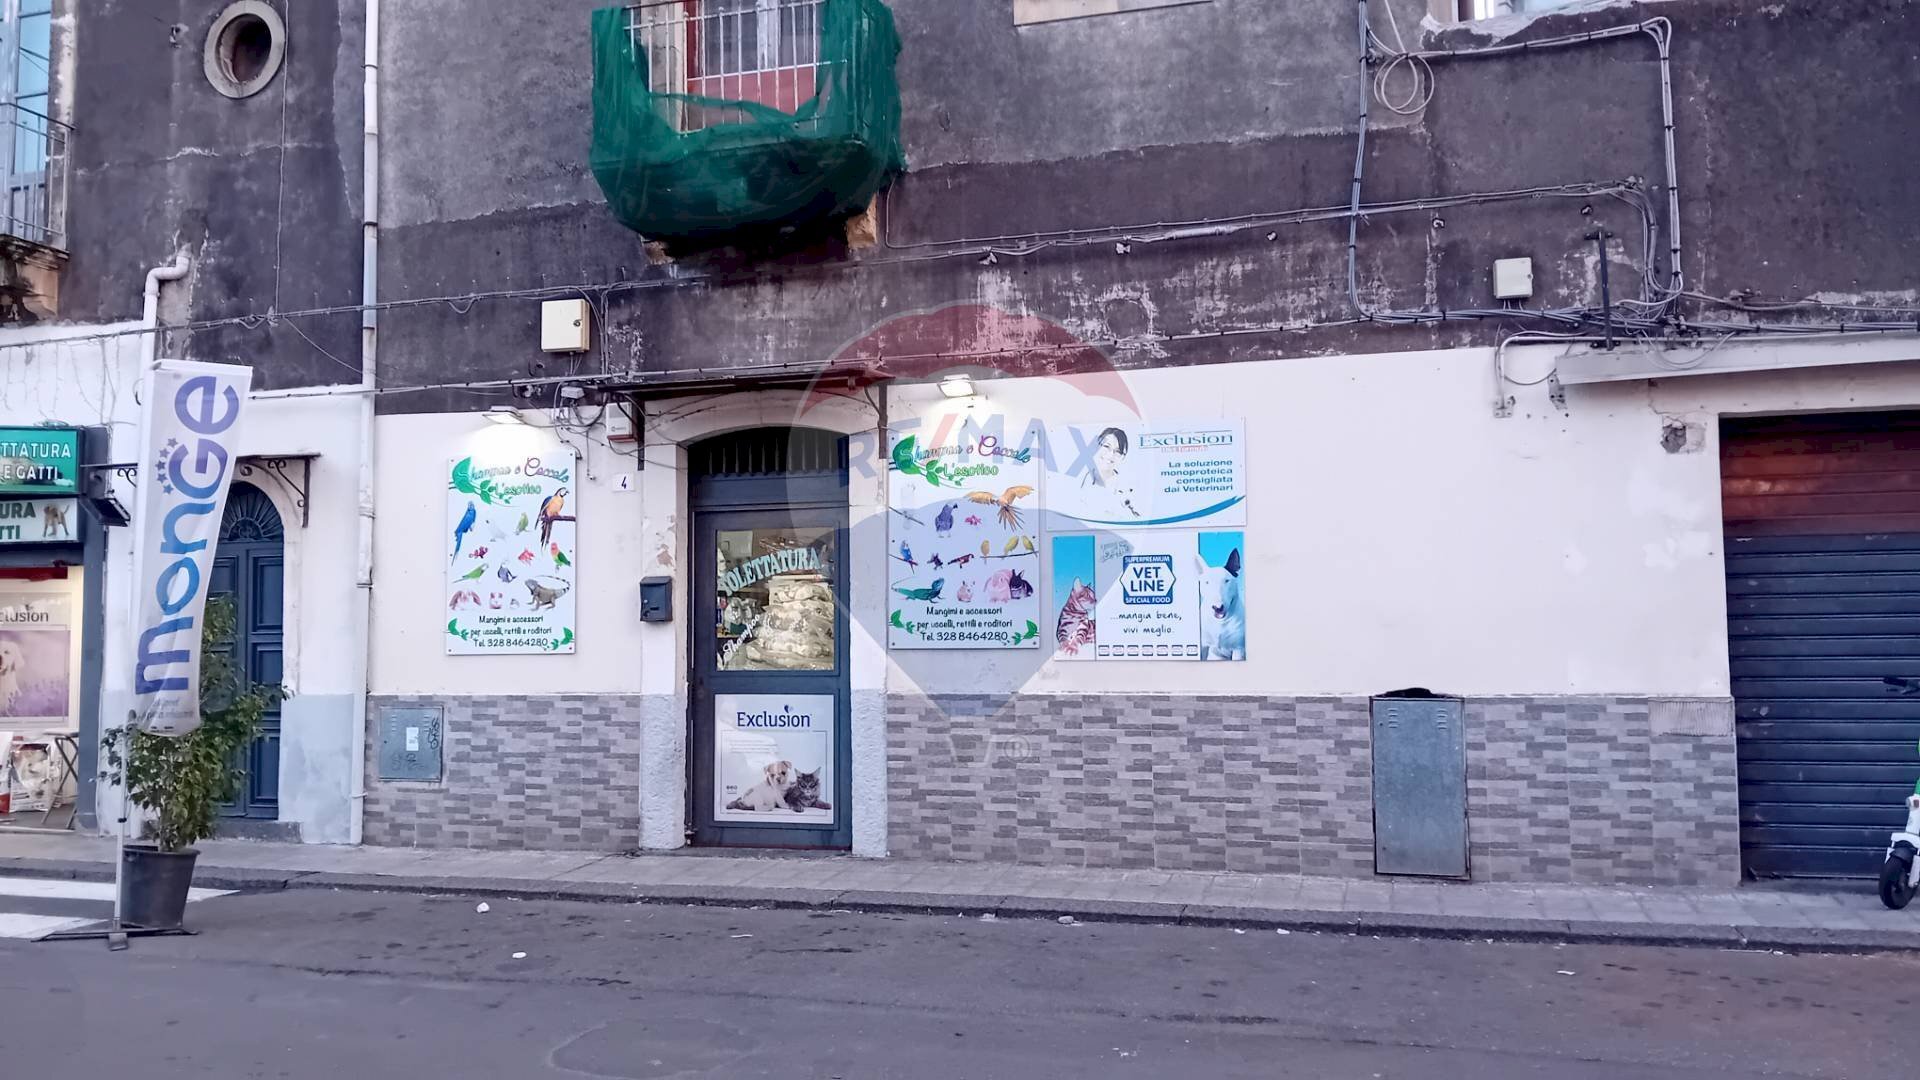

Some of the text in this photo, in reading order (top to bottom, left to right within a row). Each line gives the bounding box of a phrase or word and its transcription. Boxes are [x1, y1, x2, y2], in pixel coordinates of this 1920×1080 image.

[1139, 433, 1232, 447] Exclusion
[1168, 459, 1233, 469] La soluzione
[4, 465, 58, 480] E GATTI
[1160, 468, 1233, 477] monoproteica
[621, 475, 628, 490] 4
[1175, 476, 1233, 485] consigliata
[1163, 484, 1233, 493] dai Veterinari
[0, 502, 36, 519] URA
[1124, 555, 1171, 564] SUPERPREMIUM
[1132, 566, 1162, 579] VET
[1130, 579, 1165, 592] LINE
[1125, 596, 1171, 604] SPECIAL FOOD
[926, 606, 958, 617] Mangimi
[965, 606, 1002, 615] accessori
[1156, 610, 1182, 621] bene,
[479, 615, 506, 626] Mangimi
[512, 615, 544, 623] accessori
[916, 621, 929, 631] per
[930, 619, 955, 629] uccelli,
[956, 619, 976, 628] rettili
[983, 619, 1013, 628] roditori
[470, 629, 481, 638] per
[504, 627, 521, 635] rettili
[527, 626, 552, 635] roditori
[1123, 625, 1138, 634] vivi
[936, 631, 957, 641] 328
[958, 631, 1008, 641] 8464280
[487, 638, 506, 648] 328
[736, 710, 811, 728] Exclusion
